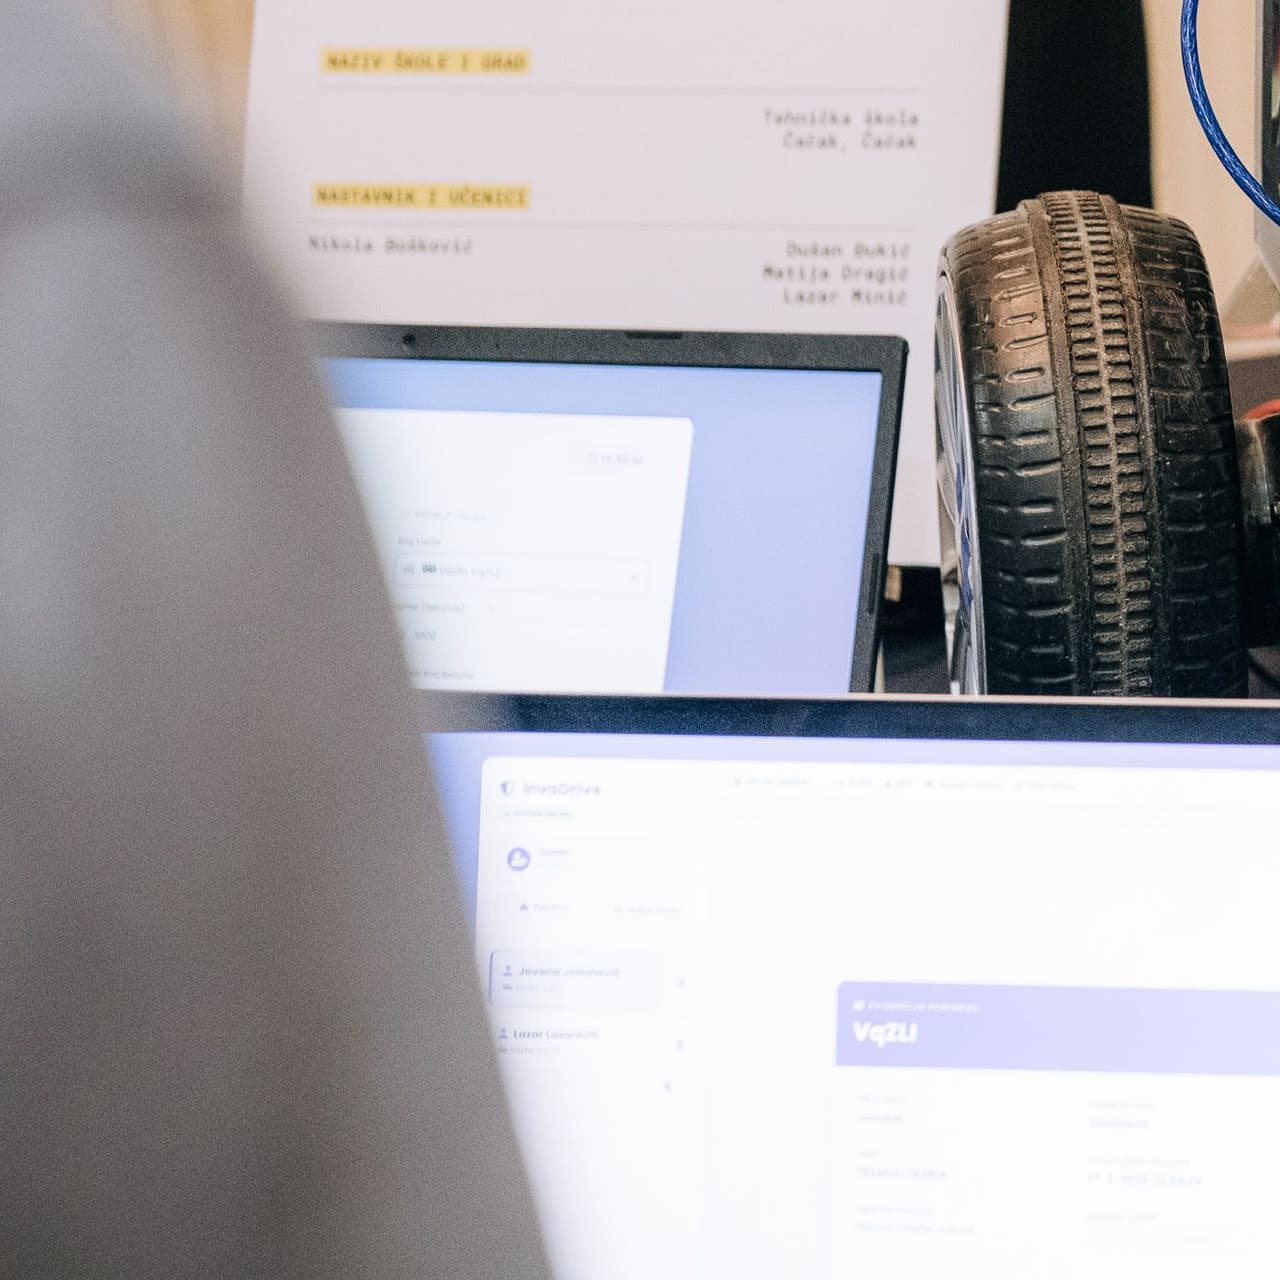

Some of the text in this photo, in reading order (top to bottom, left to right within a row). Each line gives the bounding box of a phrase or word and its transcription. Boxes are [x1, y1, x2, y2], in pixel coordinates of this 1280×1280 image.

[327, 53, 384, 72] NAZIV
[763, 109, 852, 126] Tehnička
[782, 131, 918, 152] Čačak, Čačak
[316, 187, 416, 206] NASTAVNIK
[448, 185, 528, 206] UČENICI
[308, 235, 374, 254] Nikola
[762, 264, 831, 286] Matija
[783, 288, 840, 306] Lazar
